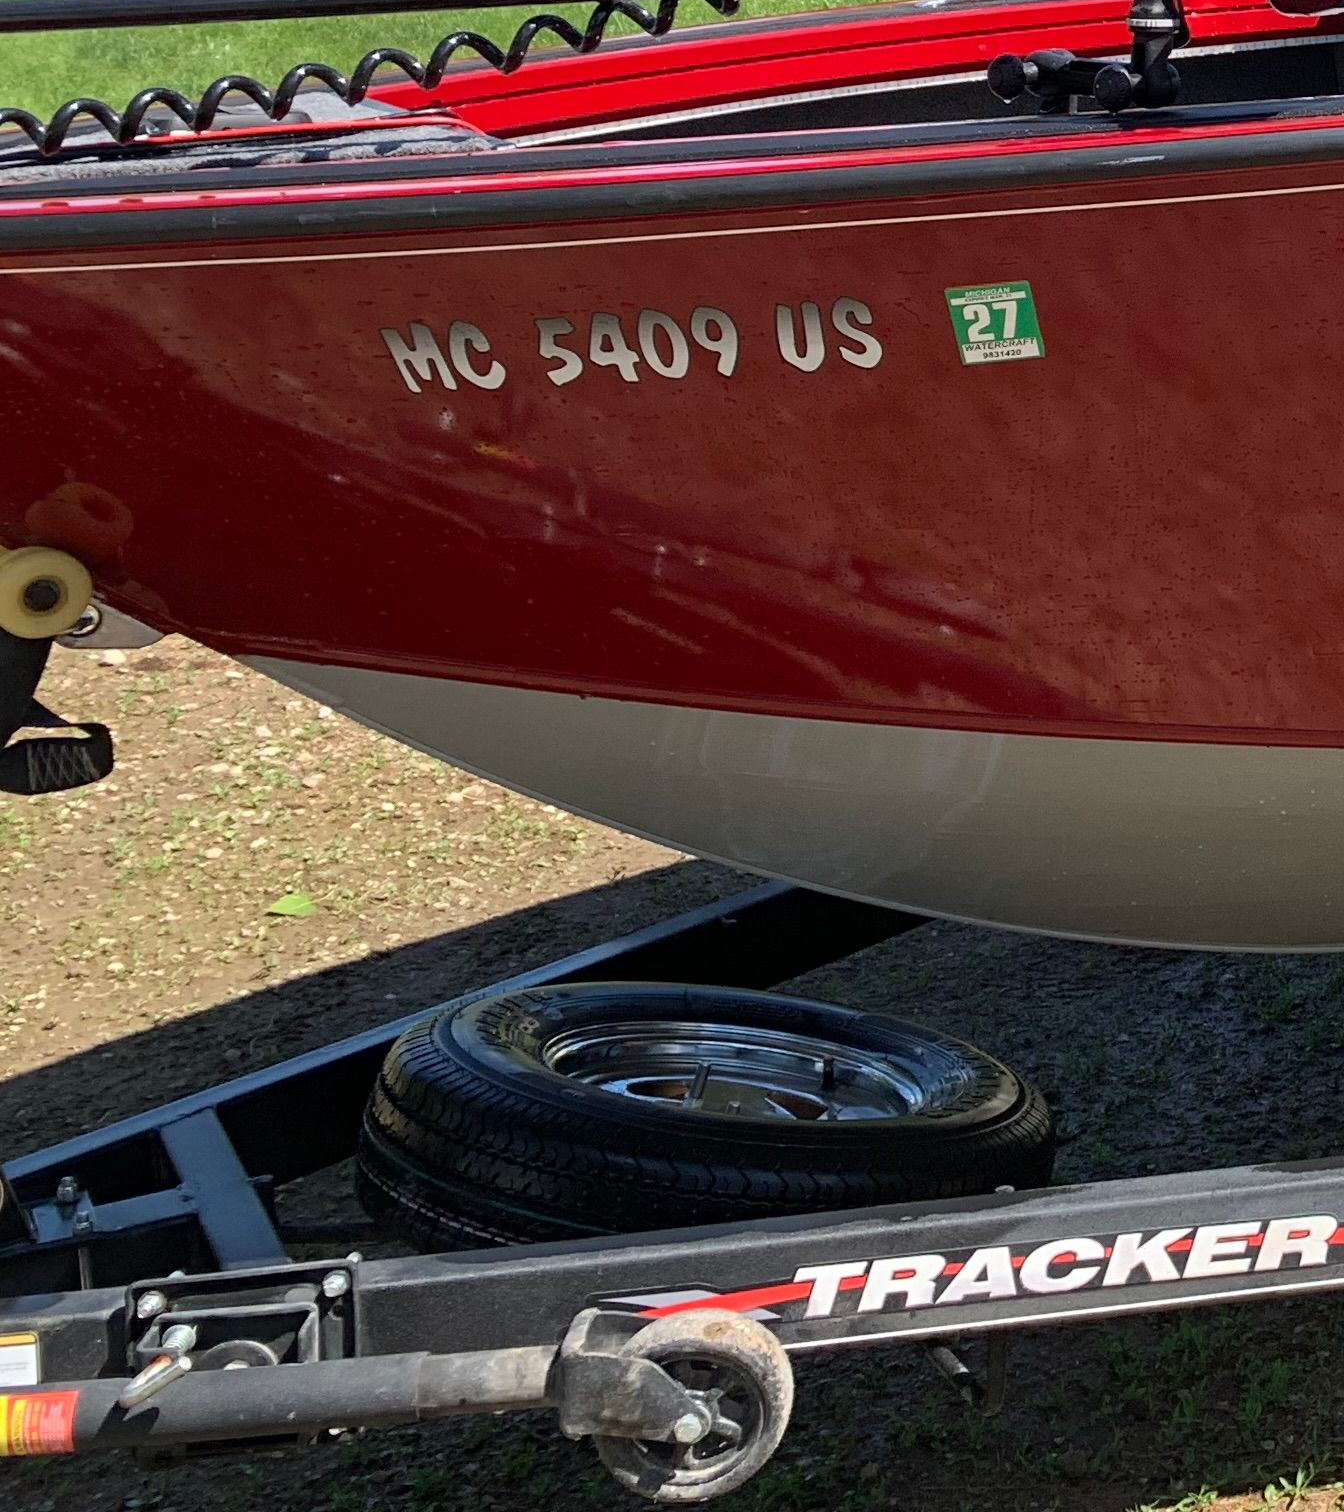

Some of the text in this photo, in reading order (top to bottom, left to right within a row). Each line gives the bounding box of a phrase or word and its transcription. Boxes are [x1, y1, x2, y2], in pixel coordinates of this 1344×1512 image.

[965, 287, 1011, 297] MICHIGAN
[962, 300, 1018, 343] 27
[379, 295, 883, 393] MC 5409 US
[964, 337, 1035, 352] WATERCRAFT
[794, 1214, 1339, 1320] TRACKER
